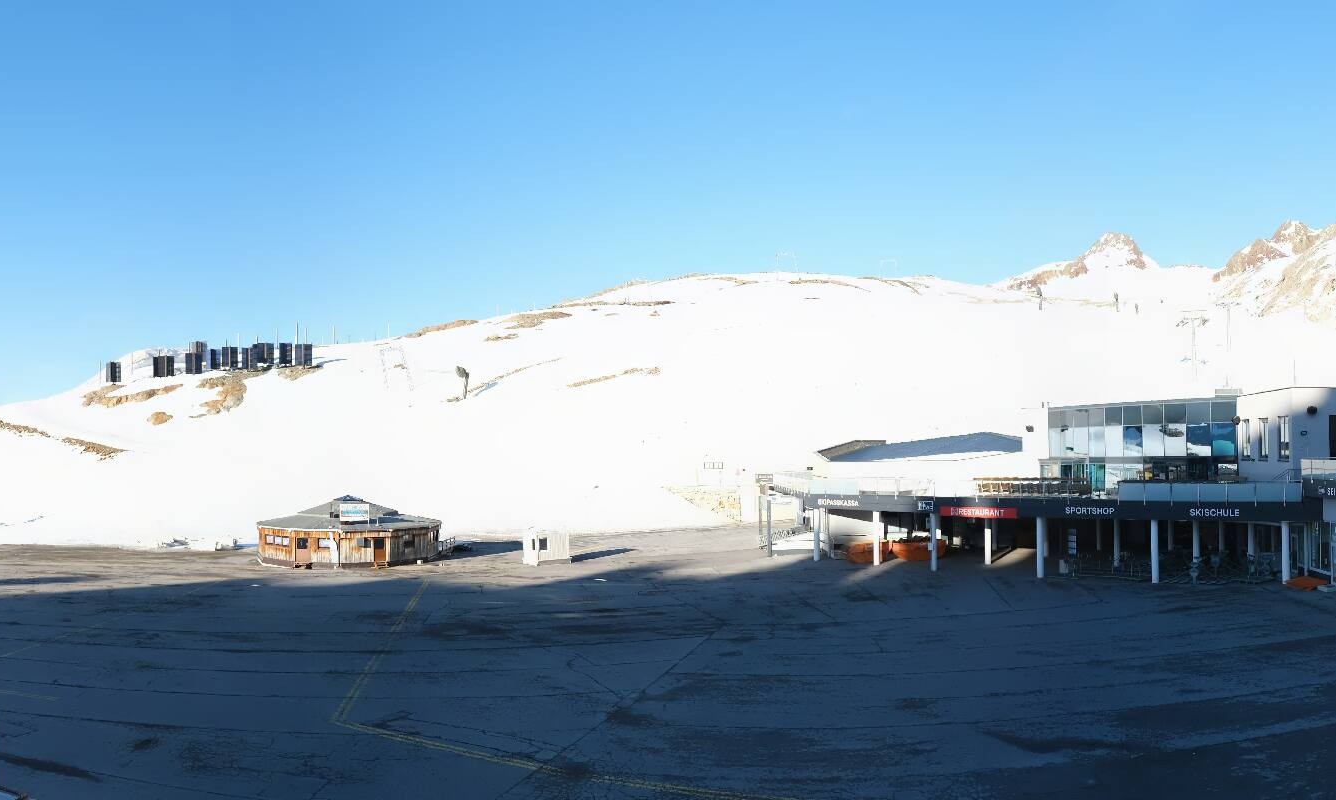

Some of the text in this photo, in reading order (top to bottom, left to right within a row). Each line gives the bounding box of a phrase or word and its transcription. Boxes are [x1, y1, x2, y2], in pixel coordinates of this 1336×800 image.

[958, 507, 1005, 517] RESTAURANT
[1065, 506, 1115, 515] SPORTSHOP
[1189, 508, 1240, 517] SKISCHULE
